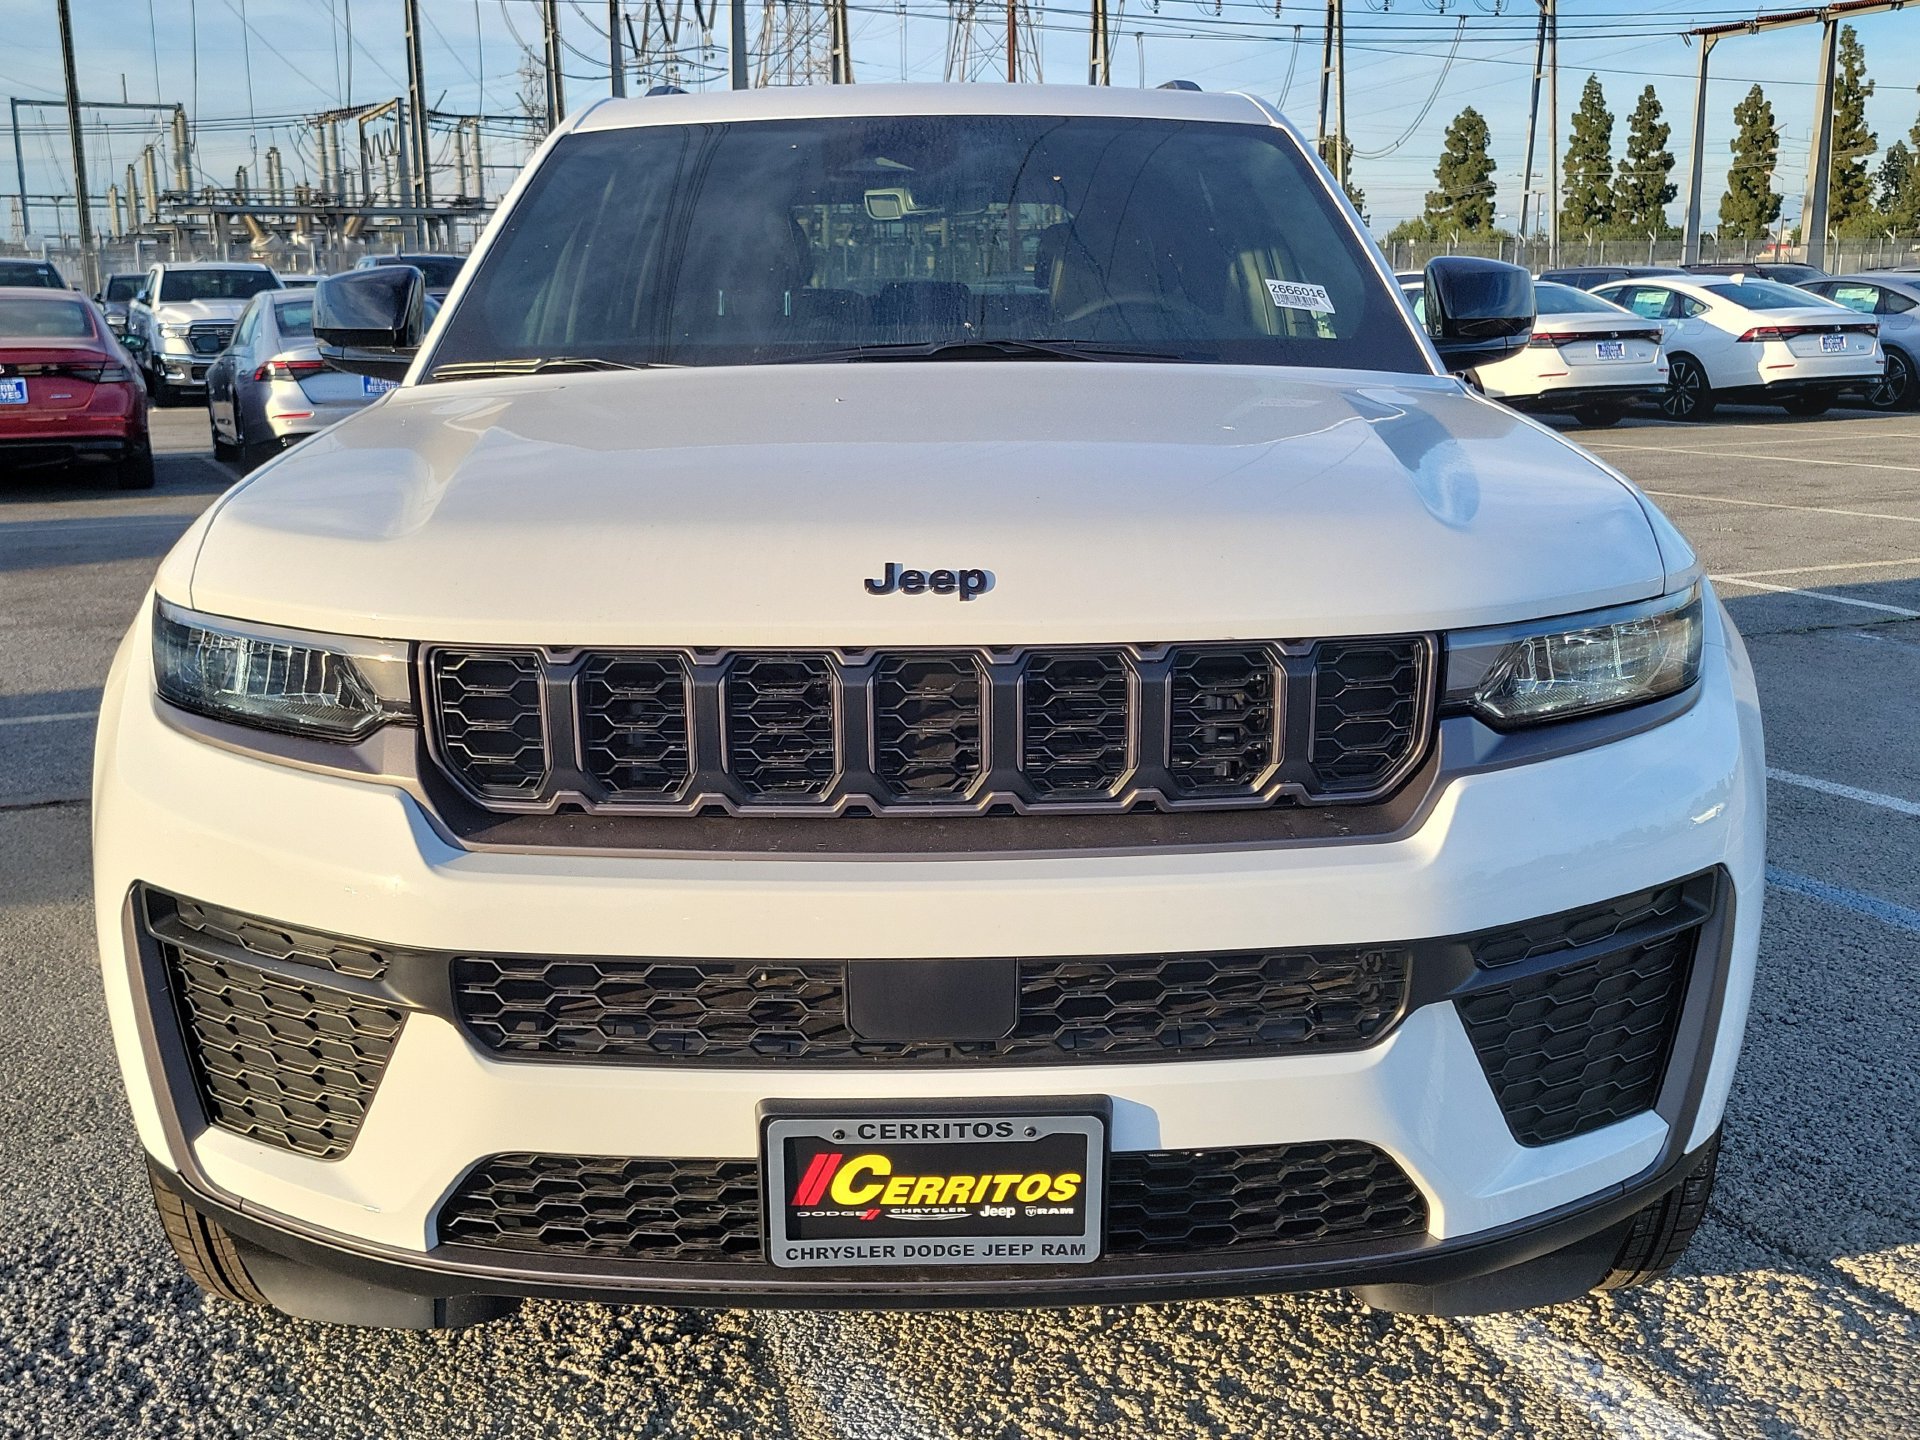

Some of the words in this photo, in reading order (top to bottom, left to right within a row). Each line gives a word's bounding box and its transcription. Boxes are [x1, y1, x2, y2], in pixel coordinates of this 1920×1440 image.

[1269, 283, 1326, 299] 2666016
[0, 383, 16, 392] RM
[864, 562, 989, 601] Jeep
[857, 1122, 1014, 1140] CERRITOS
[831, 1153, 1082, 1206] CERRITOS
[797, 1210, 869, 1218] DODGE
[979, 1204, 1016, 1219] Jeep
[1036, 1207, 1075, 1215] RAM
[785, 1246, 897, 1261] CHRYSLER
[903, 1243, 975, 1258] DODGE
[982, 1243, 1034, 1257] JEEP
[1041, 1243, 1086, 1257] RAM
